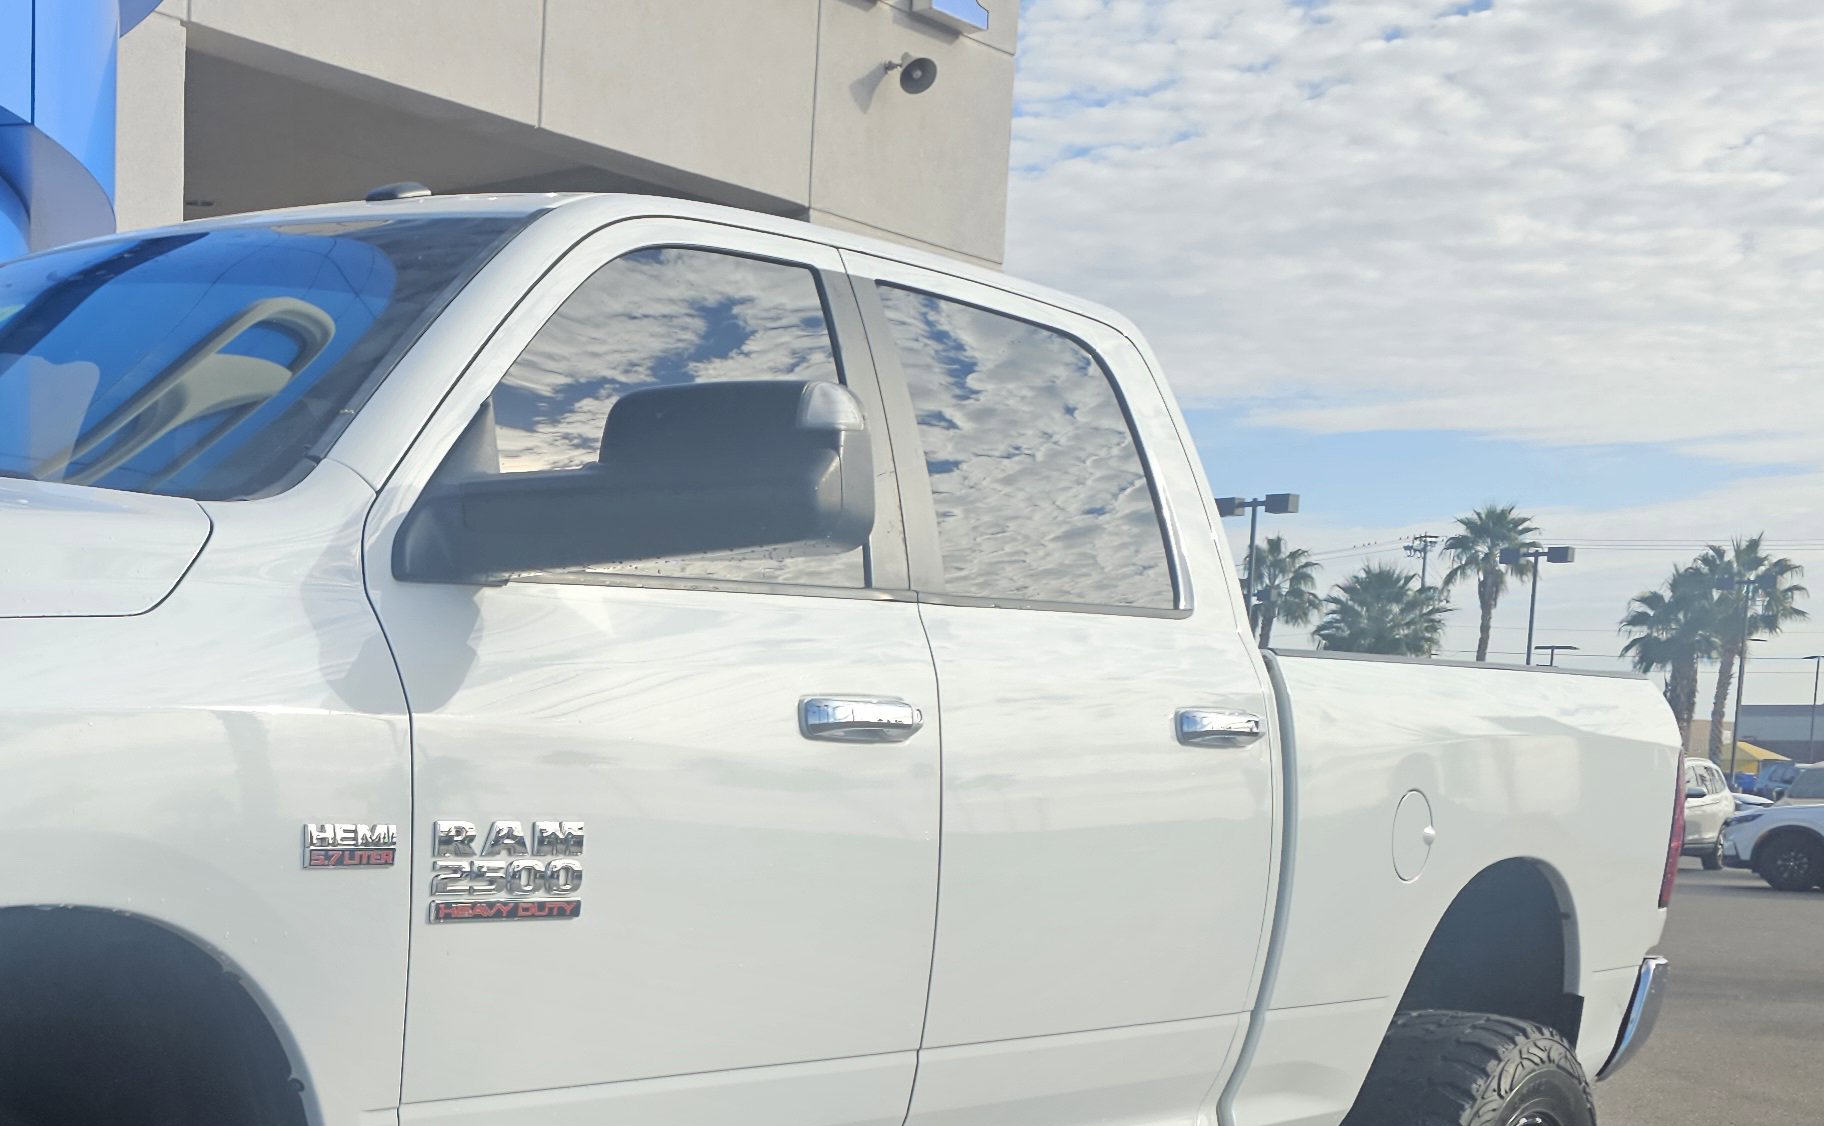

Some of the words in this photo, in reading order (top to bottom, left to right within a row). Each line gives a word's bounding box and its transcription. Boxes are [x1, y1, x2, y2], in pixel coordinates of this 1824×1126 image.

[303, 823, 396, 847] HEMI
[432, 820, 584, 856] RAM
[309, 850, 343, 866] 5.7
[343, 849, 394, 865] LITER
[431, 859, 583, 896] 2500
[438, 902, 514, 918] HEAVY
[517, 901, 577, 917] DUTY
